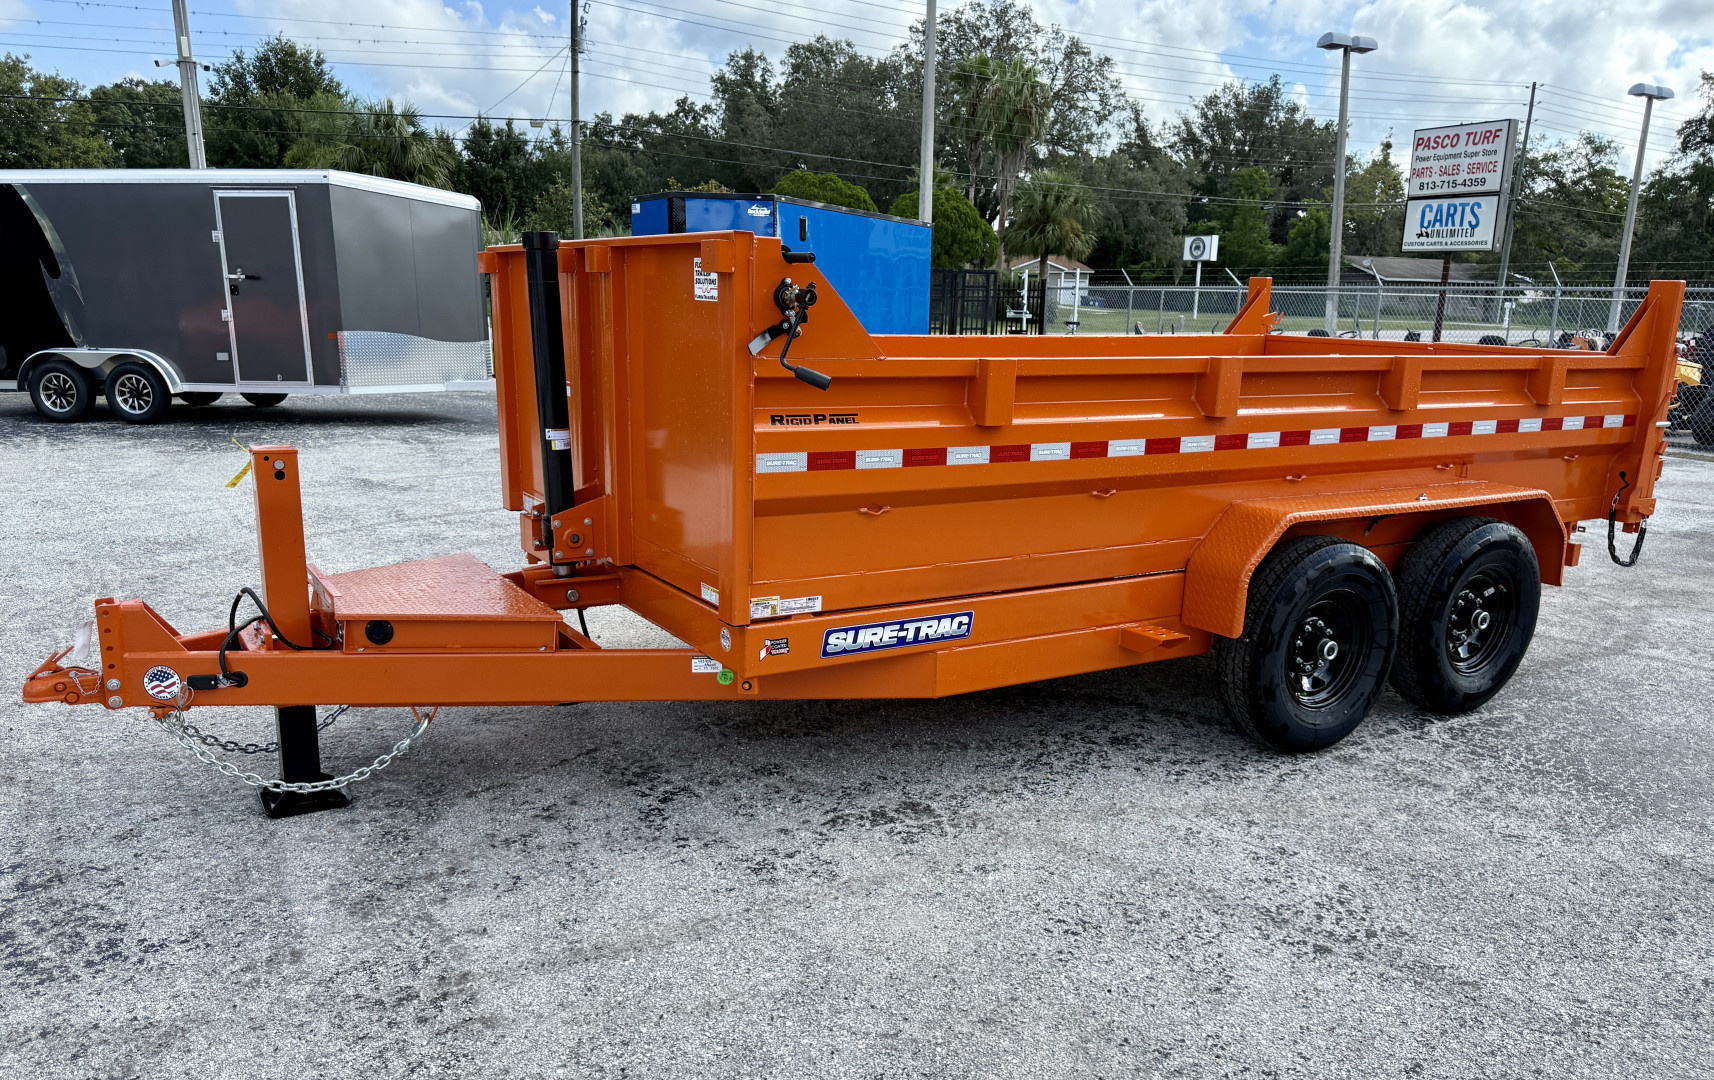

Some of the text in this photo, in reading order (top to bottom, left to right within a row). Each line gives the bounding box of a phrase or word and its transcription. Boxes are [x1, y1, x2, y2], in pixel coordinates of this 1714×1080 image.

[1415, 128, 1502, 152] PASCO TURF
[1415, 148, 1498, 163] Power Equipment Super Store
[1412, 166, 1433, 179] PARTS
[1438, 163, 1461, 177] SALES
[1466, 160, 1498, 175] SERVICE
[1418, 177, 1487, 191] 813-715-4359
[1419, 201, 1482, 230] CARTS
[1429, 227, 1475, 239] UNLIMITED
[1449, 239, 1488, 247] ACCESSORIES
[770, 413, 860, 426] RIGID PANEL
[826, 616, 969, 653] SURE-TRAC
